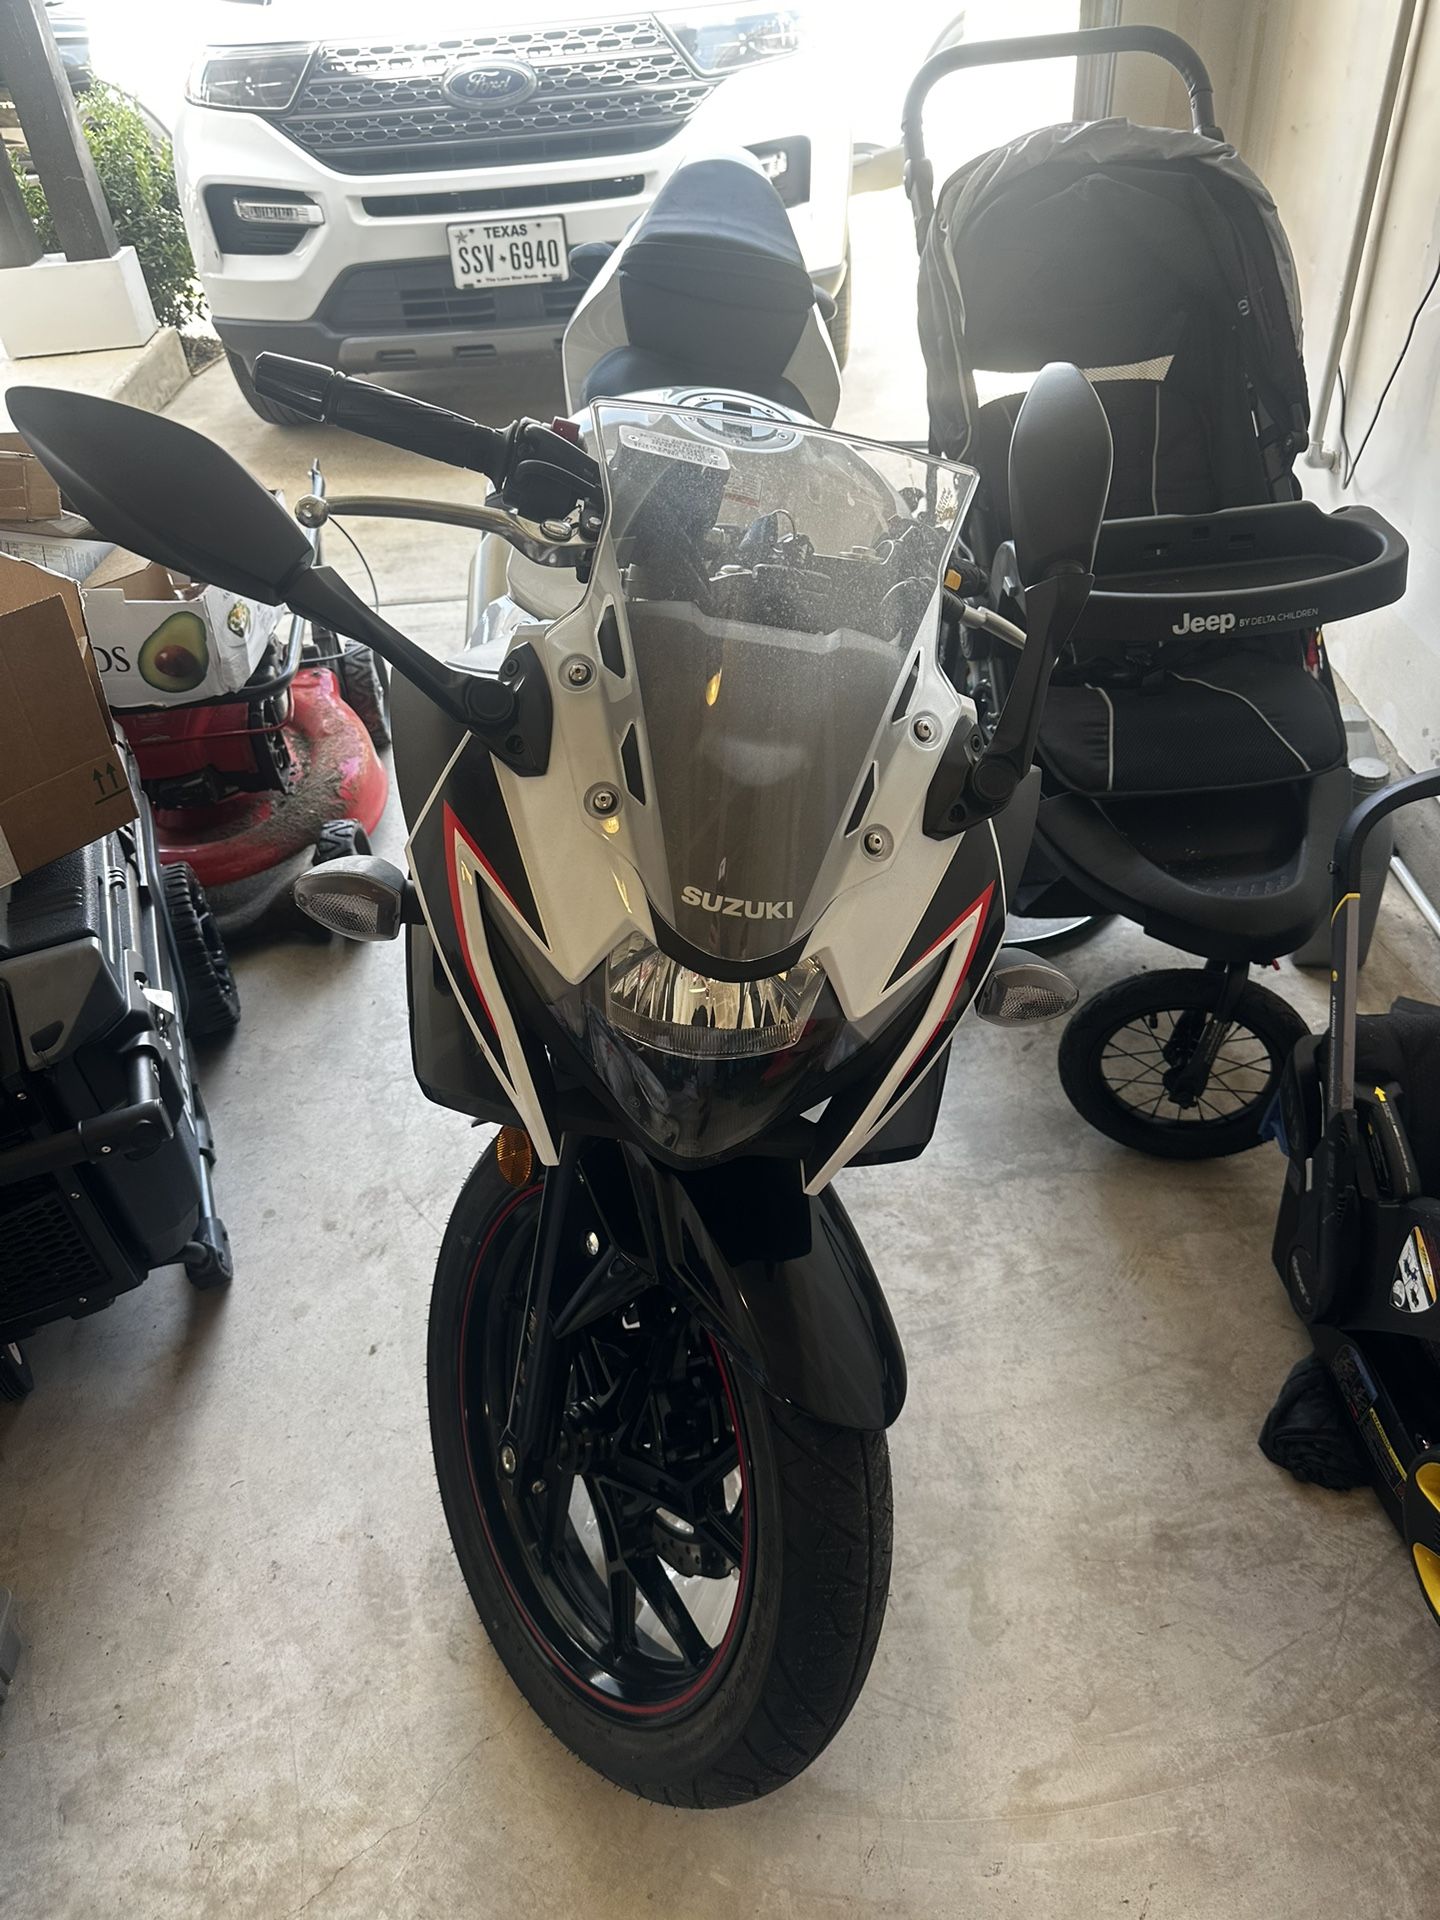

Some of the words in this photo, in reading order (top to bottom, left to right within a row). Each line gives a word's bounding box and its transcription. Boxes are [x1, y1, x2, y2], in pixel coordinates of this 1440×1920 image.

[465, 71, 512, 95] Ford
[483, 224, 528, 239] TEXAS
[458, 244, 494, 274] SSV
[509, 239, 560, 270] 6940
[1172, 612, 1236, 635] Jeep
[1239, 618, 1251, 627] BY
[1251, 614, 1276, 626] DELTA
[1277, 608, 1319, 622] CHILDREN
[681, 885, 793, 919] SUZUKI
